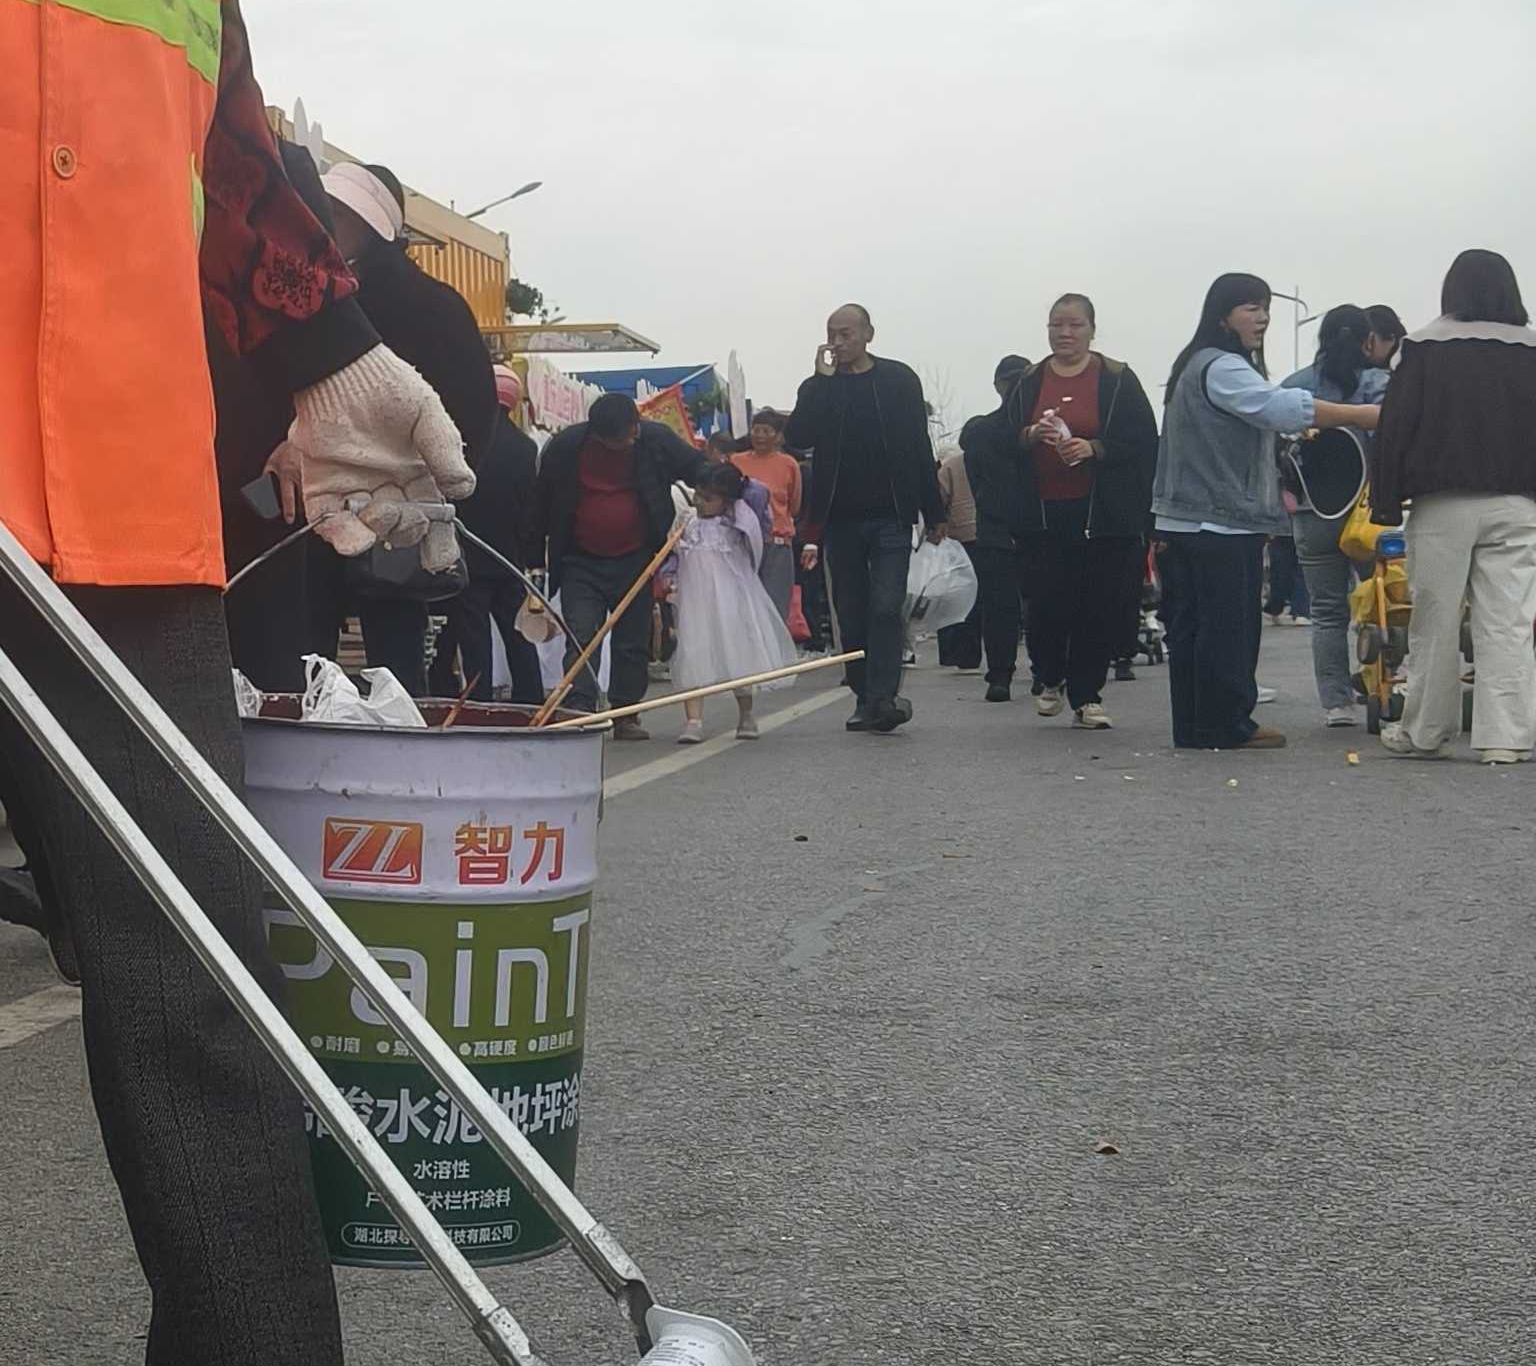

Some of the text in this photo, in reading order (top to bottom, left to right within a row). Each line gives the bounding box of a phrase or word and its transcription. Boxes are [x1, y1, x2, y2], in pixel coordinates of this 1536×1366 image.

[454, 820, 565, 885] 智力
[473, 1039, 518, 1058] 高硬度
[413, 1159, 471, 1180] 水溶性
[365, 1187, 512, 1212] 户术栏杆涂料
